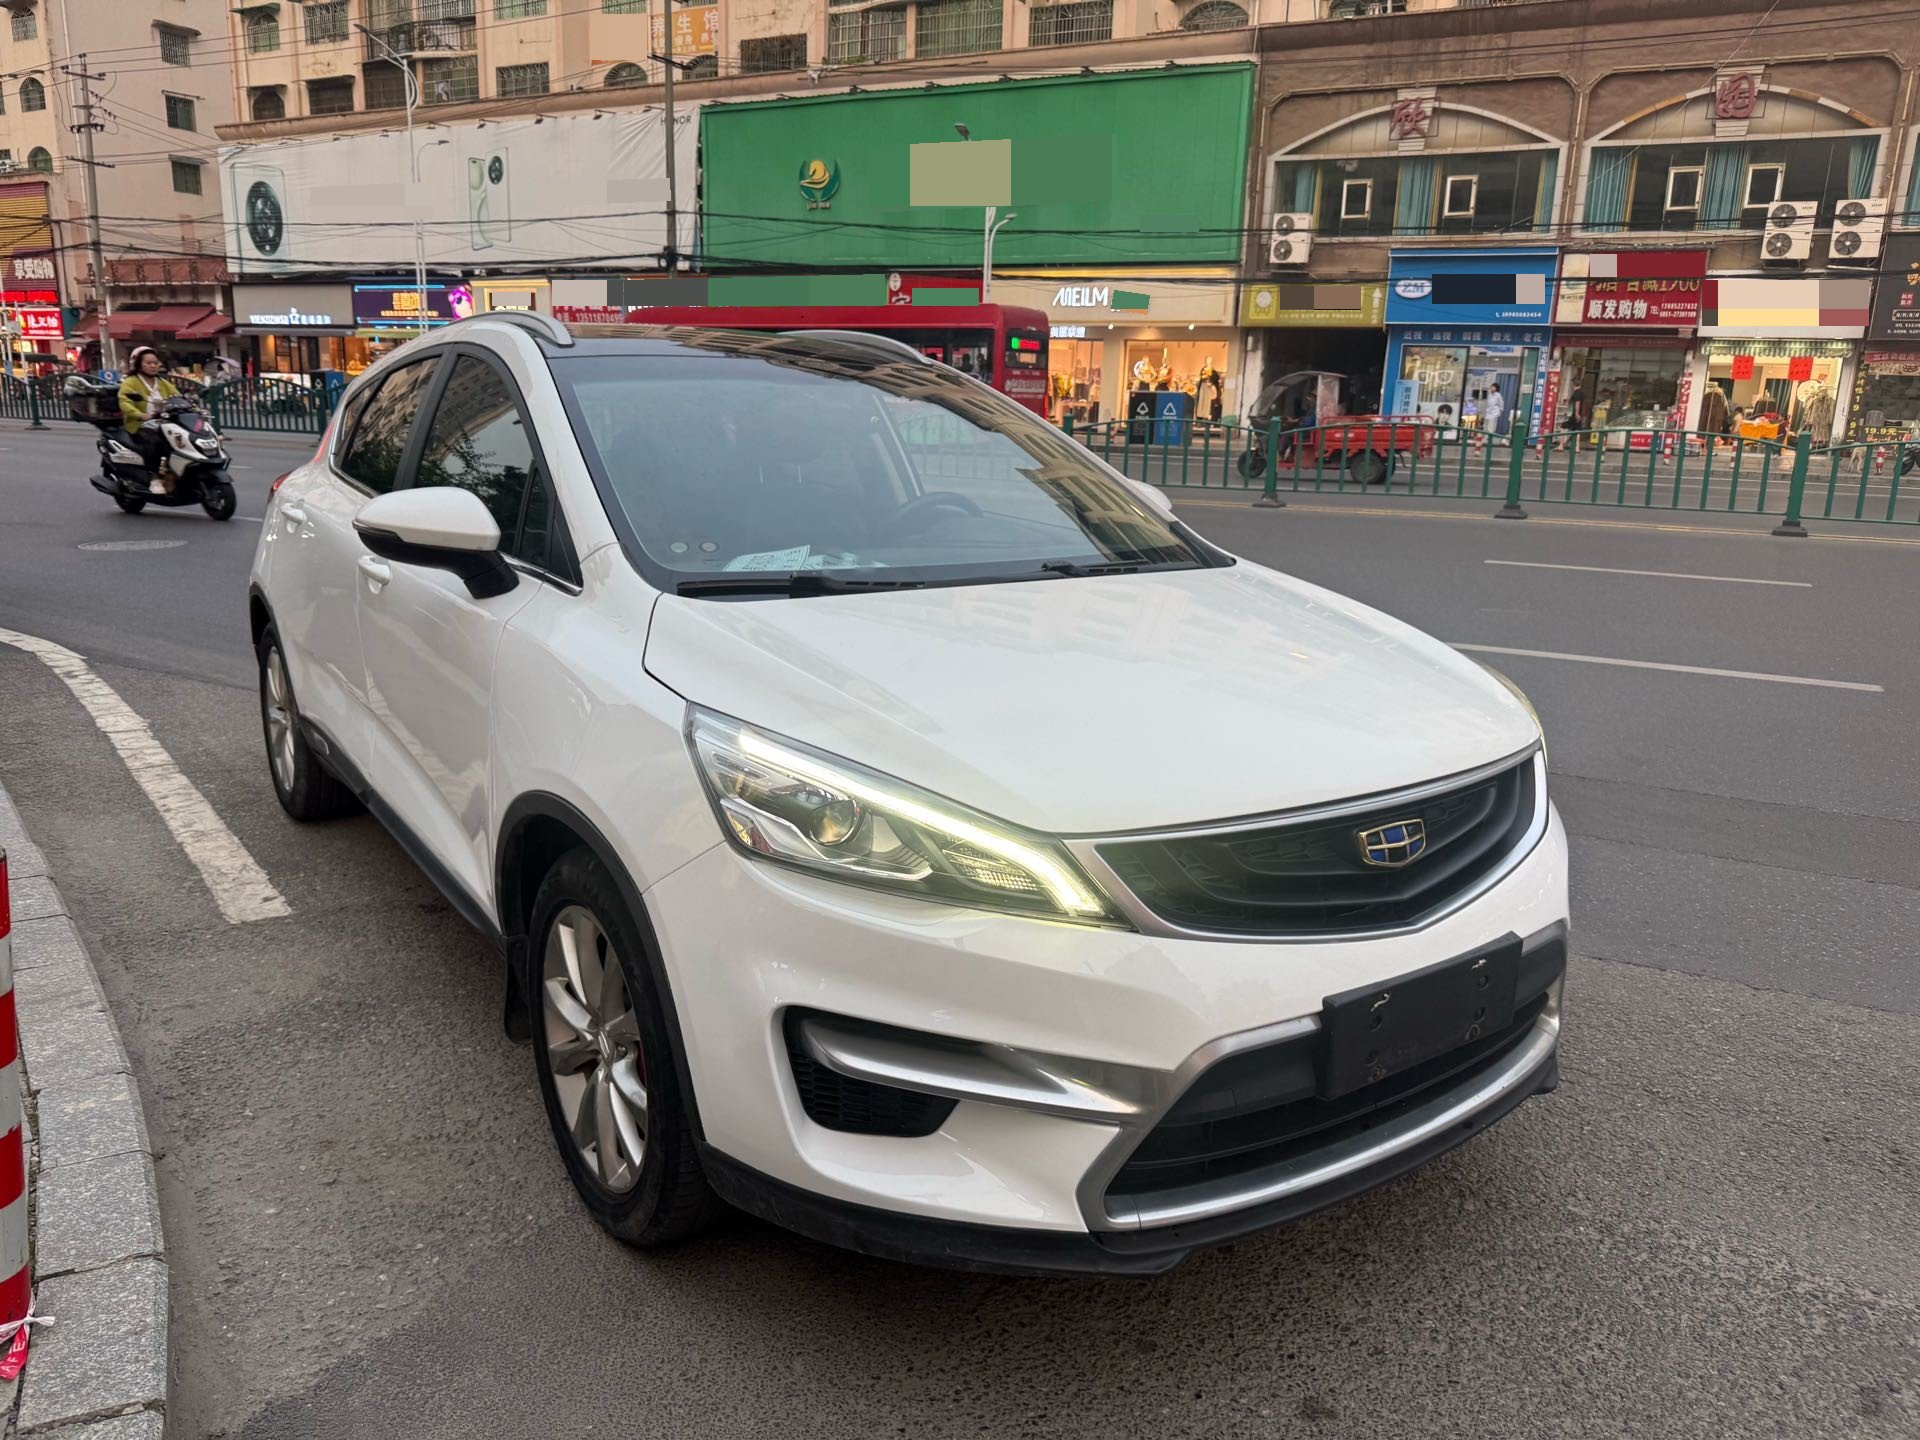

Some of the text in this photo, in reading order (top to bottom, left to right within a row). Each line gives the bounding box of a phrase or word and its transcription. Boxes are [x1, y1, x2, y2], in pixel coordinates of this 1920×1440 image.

[652, 9, 719, 37] 养生馆
[660, 115, 692, 125] HNOR
[13, 257, 55, 280] 享受购物
[1587, 299, 1648, 320] 顺发购物
[1492, 332, 1512, 342] 散光
[1523, 332, 1543, 343] 老花
